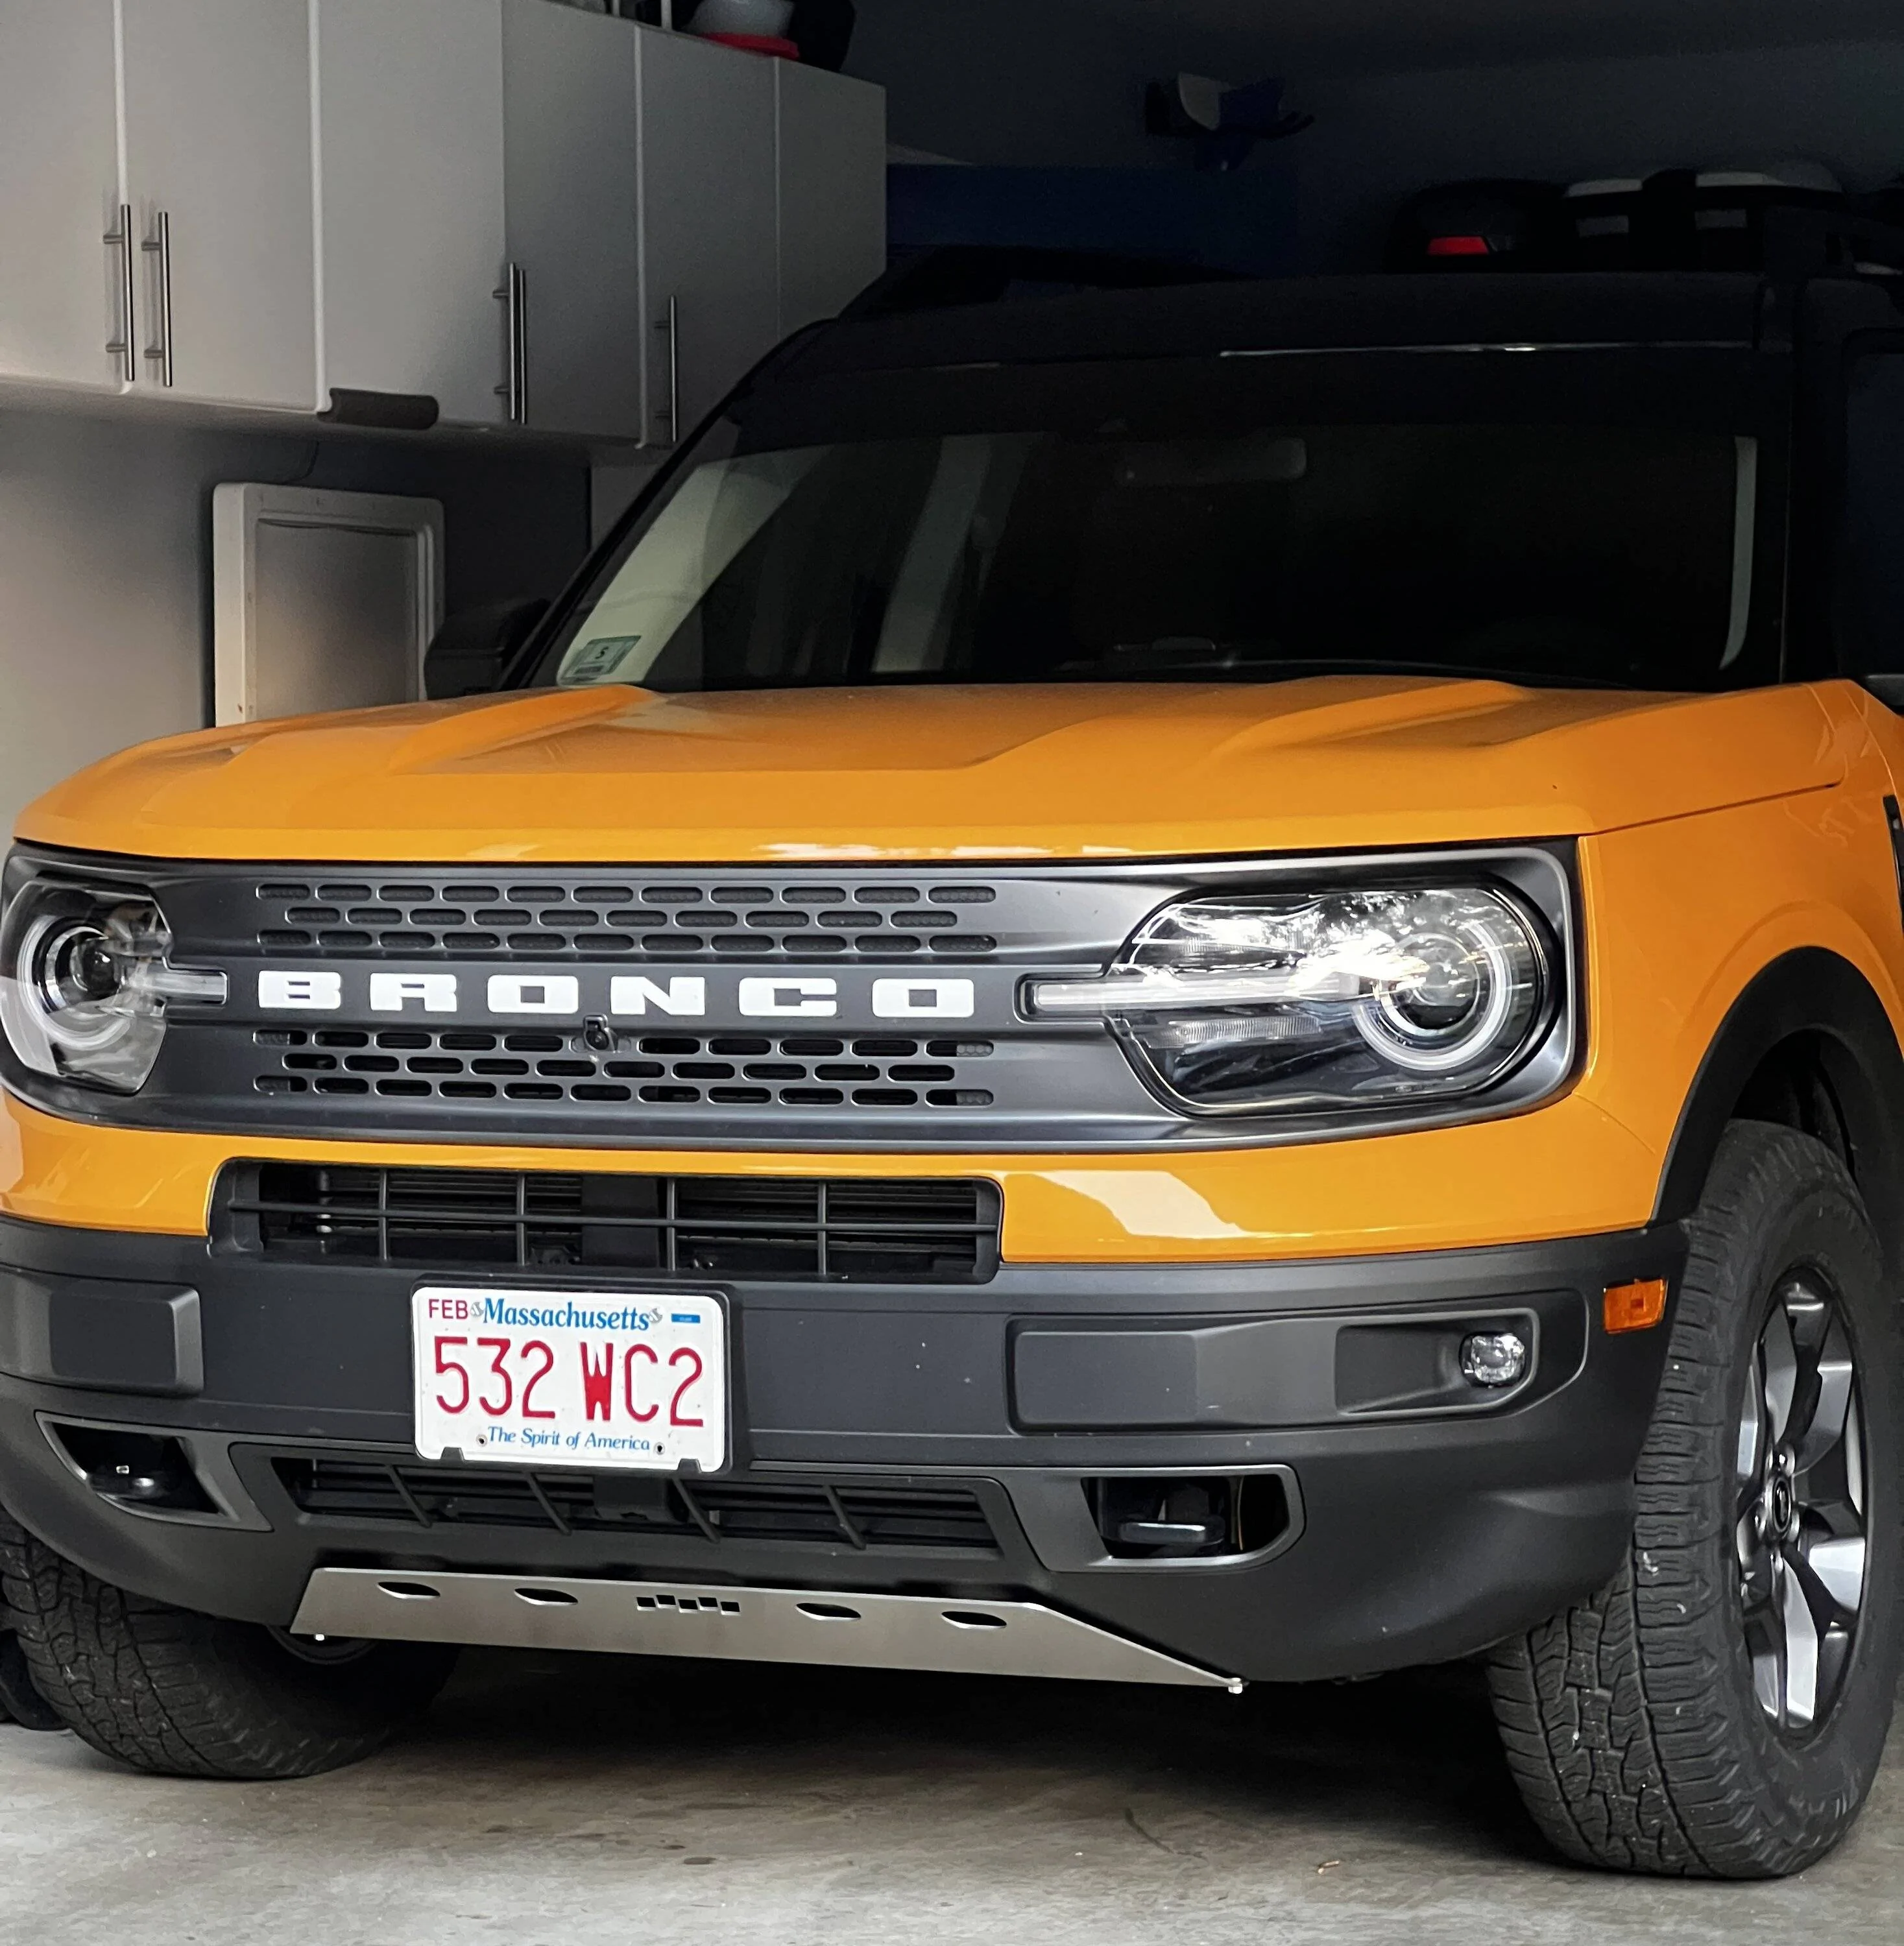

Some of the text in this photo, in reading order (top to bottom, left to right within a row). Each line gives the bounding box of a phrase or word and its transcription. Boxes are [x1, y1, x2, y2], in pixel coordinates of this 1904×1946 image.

[258, 970, 974, 1017] BRONCO
[428, 1298, 468, 1319] FEB
[483, 1297, 649, 1330] Massachusetts
[434, 1335, 704, 1426] 532 WC2
[488, 1426, 649, 1451] The Spirit of America
